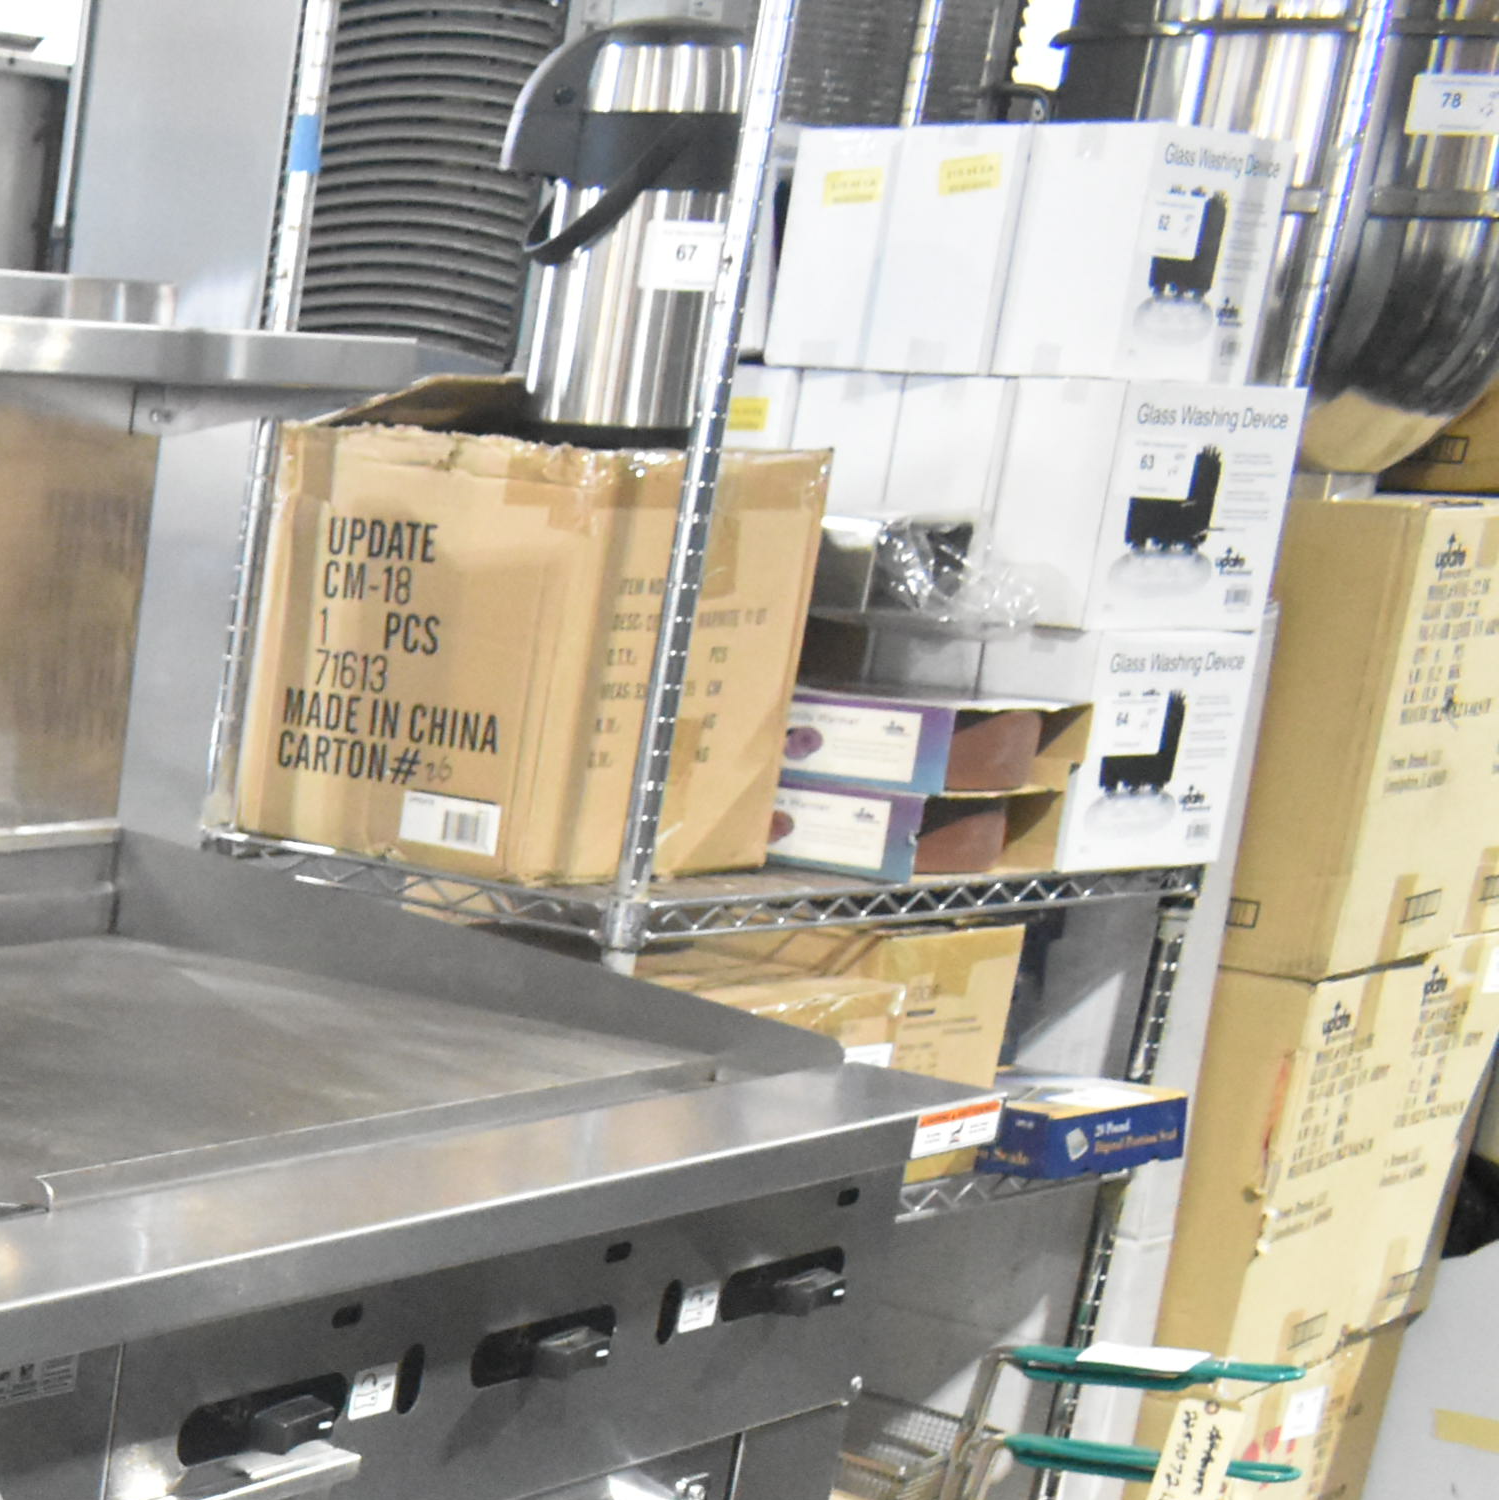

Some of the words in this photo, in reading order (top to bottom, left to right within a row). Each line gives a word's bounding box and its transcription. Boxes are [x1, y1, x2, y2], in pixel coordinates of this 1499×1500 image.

[1441, 92, 1462, 109] 78
[1164, 142, 1196, 167] Glass
[1198, 148, 1242, 179] Washing
[1244, 153, 1281, 179] Device
[675, 243, 698, 262] 67
[1137, 402, 1177, 426] Glass
[1181, 405, 1239, 433] Washing
[1242, 406, 1289, 430] Device
[1139, 454, 1154, 470] 63
[328, 516, 439, 563] UPDATE
[323, 560, 412, 605] CM-18
[320, 606, 328, 646] 1
[384, 611, 441, 655] PCS
[315, 648, 389, 693] 71613
[1110, 652, 1146, 673] Glass
[1150, 652, 1203, 677] Washing
[1205, 651, 1246, 673] Device
[283, 687, 362, 736] MADE
[369, 698, 401, 740] IN
[408, 703, 499, 755] CHINA
[1115, 711, 1130, 727] 64
